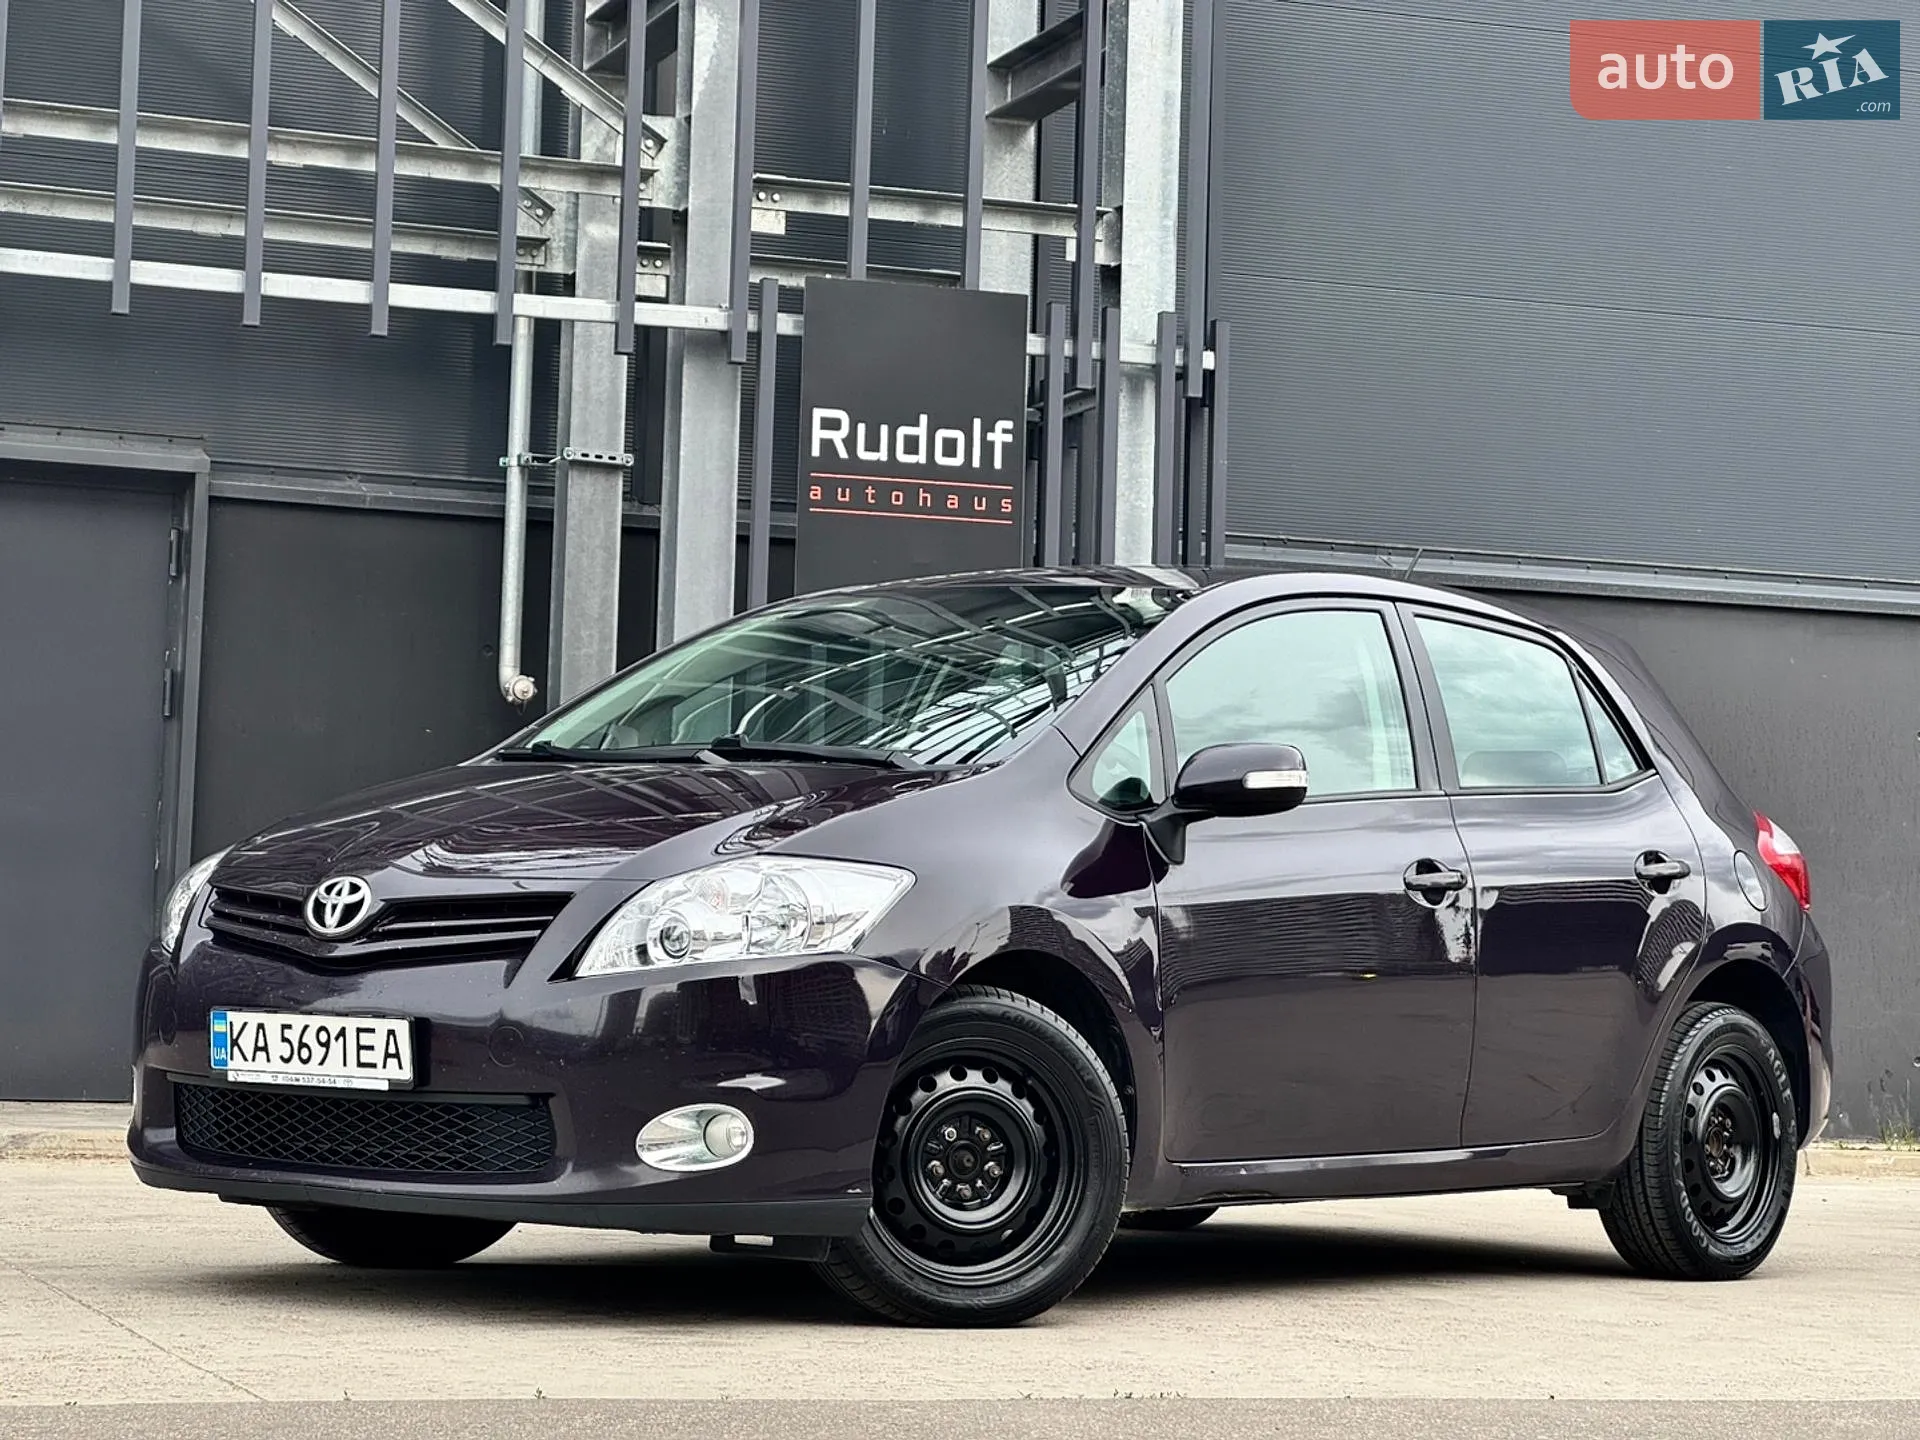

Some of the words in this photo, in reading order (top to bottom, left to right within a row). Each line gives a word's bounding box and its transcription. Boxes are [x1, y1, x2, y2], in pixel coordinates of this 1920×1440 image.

[810, 406, 1015, 470] Rudolf
[809, 485, 1013, 513] autohaus
[213, 1047, 227, 1060] UA
